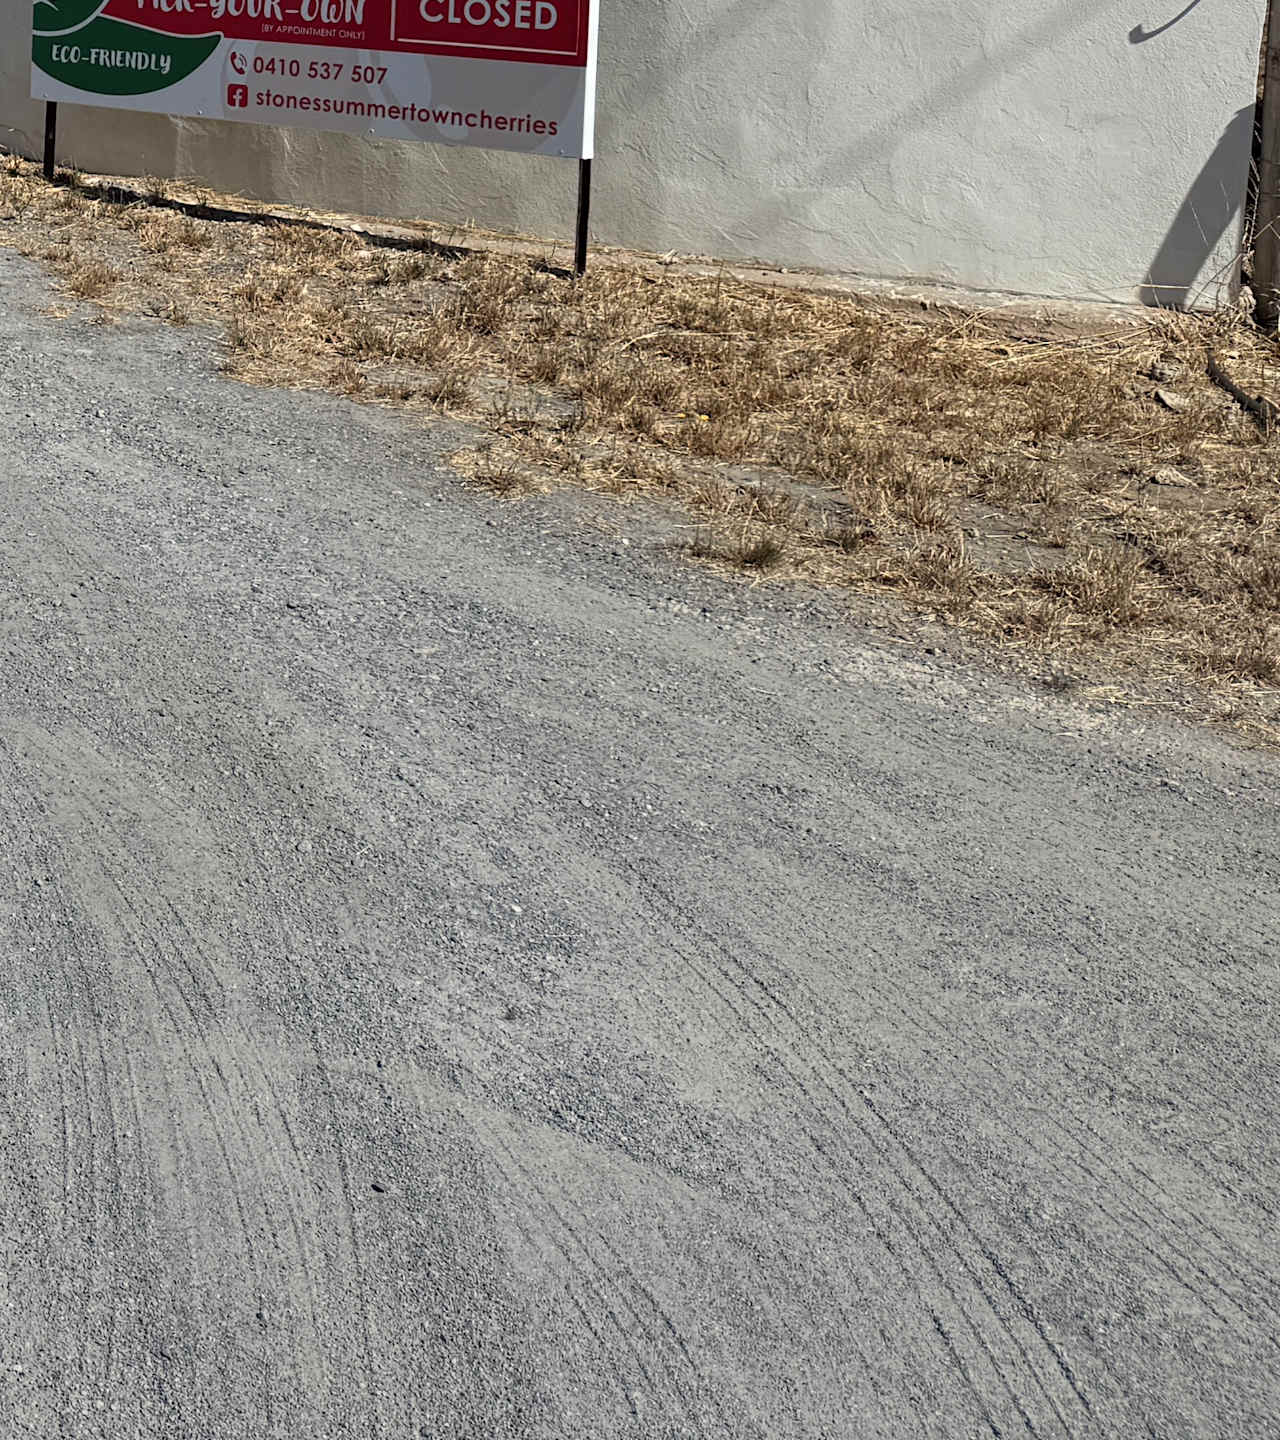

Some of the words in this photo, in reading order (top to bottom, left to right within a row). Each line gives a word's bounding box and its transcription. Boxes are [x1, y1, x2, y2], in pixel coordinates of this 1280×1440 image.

[276, 25, 336, 37] APPOINTMENT
[51, 44, 171, 74] ECO-FRIENDLY
[253, 56, 300, 77] 0410
[308, 62, 343, 81] 537
[351, 66, 387, 85] 507
[256, 89, 558, 137] stonessummertowncherries
